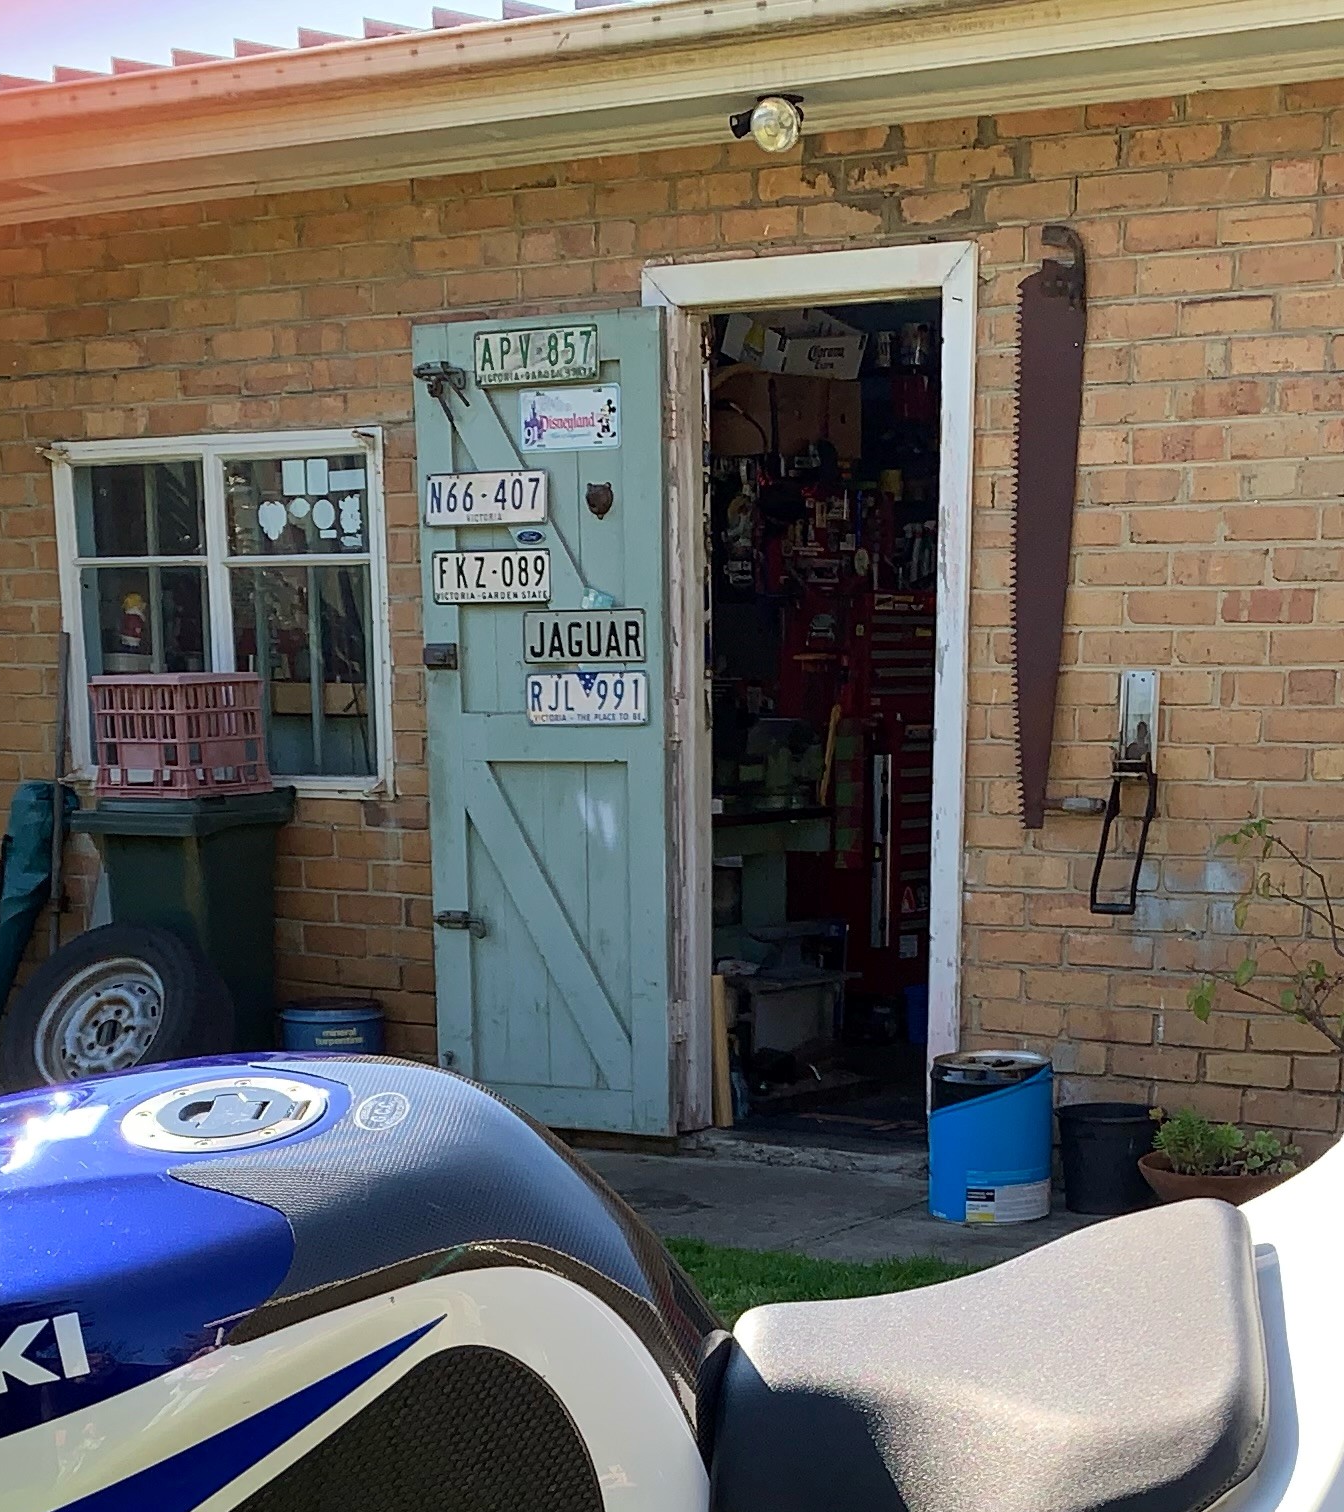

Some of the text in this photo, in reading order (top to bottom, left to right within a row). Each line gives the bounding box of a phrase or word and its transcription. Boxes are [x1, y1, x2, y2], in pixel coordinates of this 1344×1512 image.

[538, 412, 596, 433] Disneyland
[521, 590, 547, 599] STATE
[530, 621, 641, 658] JAGUAR
[577, 713, 591, 721] THE
[595, 713, 616, 721] PLACE
[619, 712, 629, 720] TO
